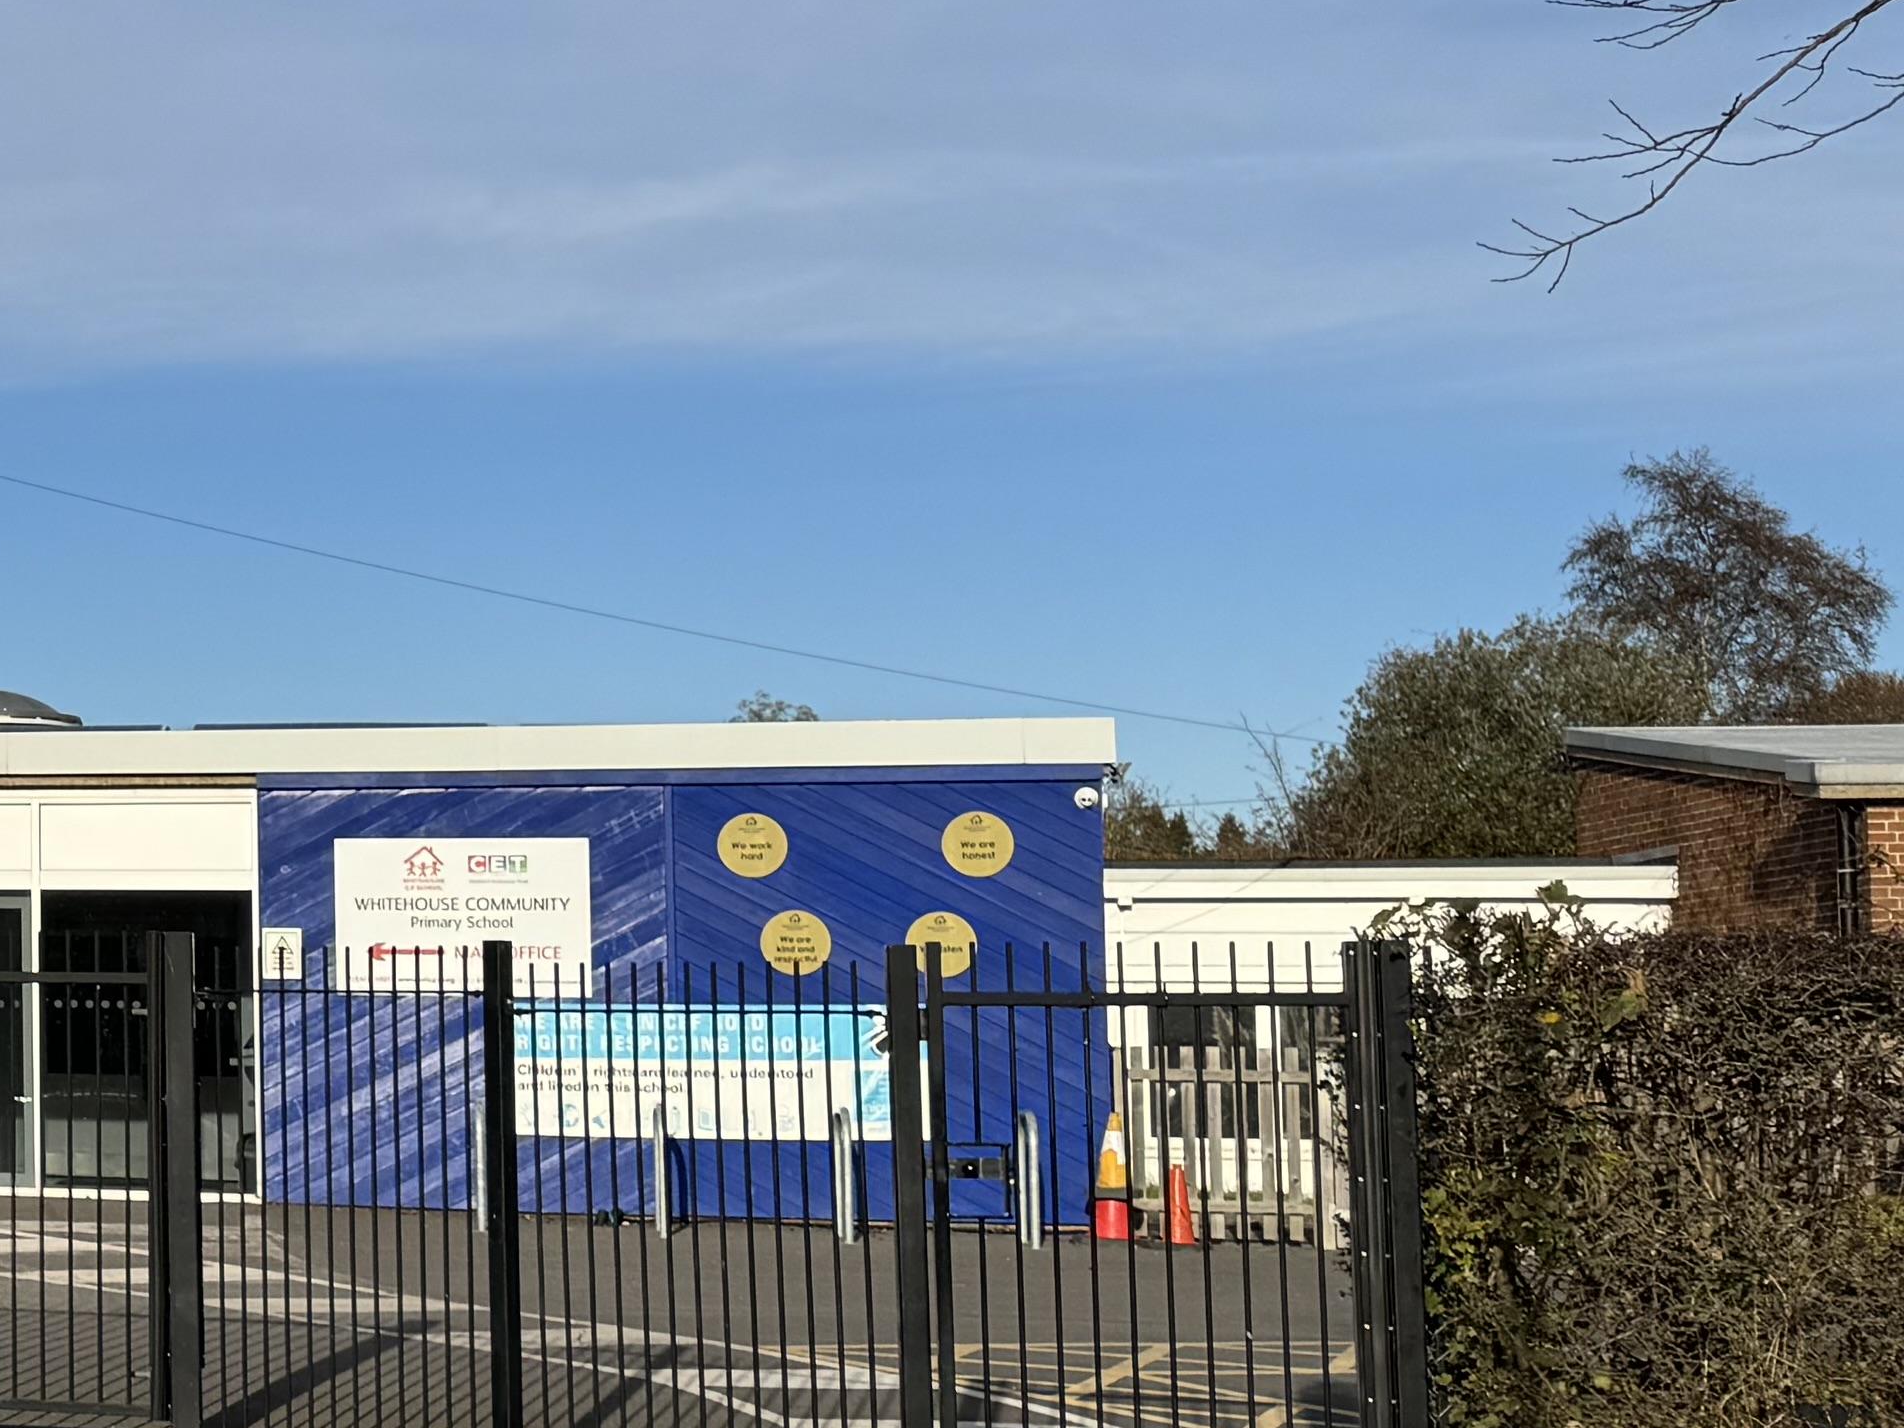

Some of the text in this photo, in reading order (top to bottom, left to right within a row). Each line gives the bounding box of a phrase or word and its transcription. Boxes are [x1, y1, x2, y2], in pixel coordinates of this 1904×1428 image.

[960, 841, 976, 849] We
[740, 852, 763, 860] hard
[962, 851, 995, 860] honest
[468, 855, 527, 873] CET
[355, 897, 570, 911] WHITEHOUSE COMMUNITY
[410, 916, 514, 931] Primary School
